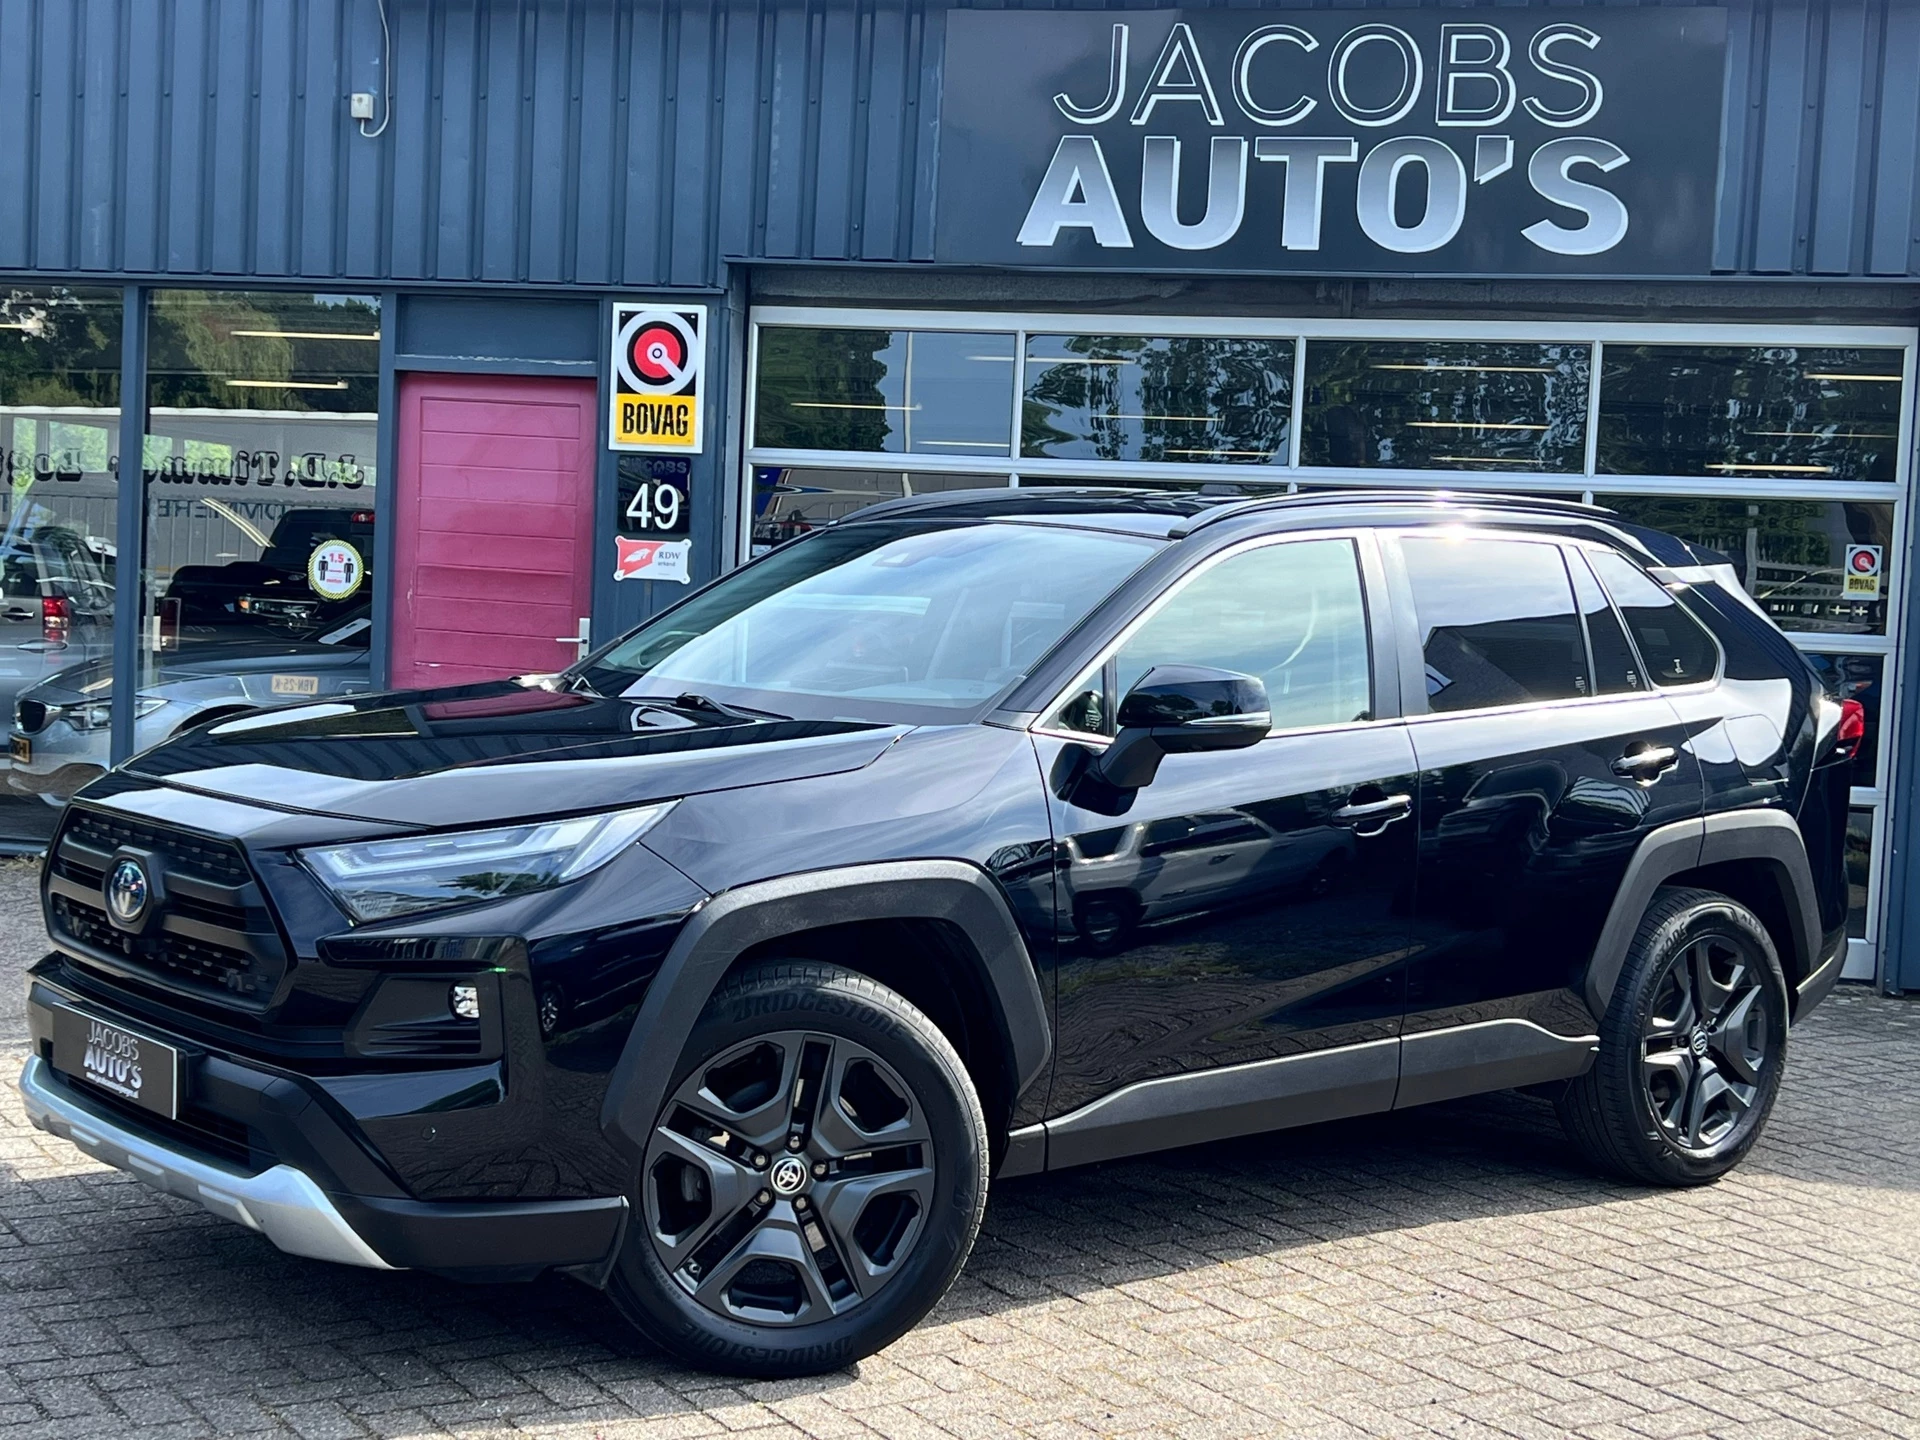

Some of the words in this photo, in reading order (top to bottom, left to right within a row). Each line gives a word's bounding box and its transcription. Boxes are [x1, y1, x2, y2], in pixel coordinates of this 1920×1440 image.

[1053, 23, 1604, 127] JACOBS
[1015, 134, 1631, 256] AUTO'S
[621, 402, 689, 437] BOVAG
[626, 482, 680, 530] 49
[329, 552, 345, 564] 1.5
[658, 551, 681, 560] RDW
[1848, 578, 1876, 591] BOVAG
[733, 992, 908, 1041] BRIDGESTONE
[86, 1021, 140, 1061] JACOBS
[83, 1044, 142, 1089] AUTO'S
